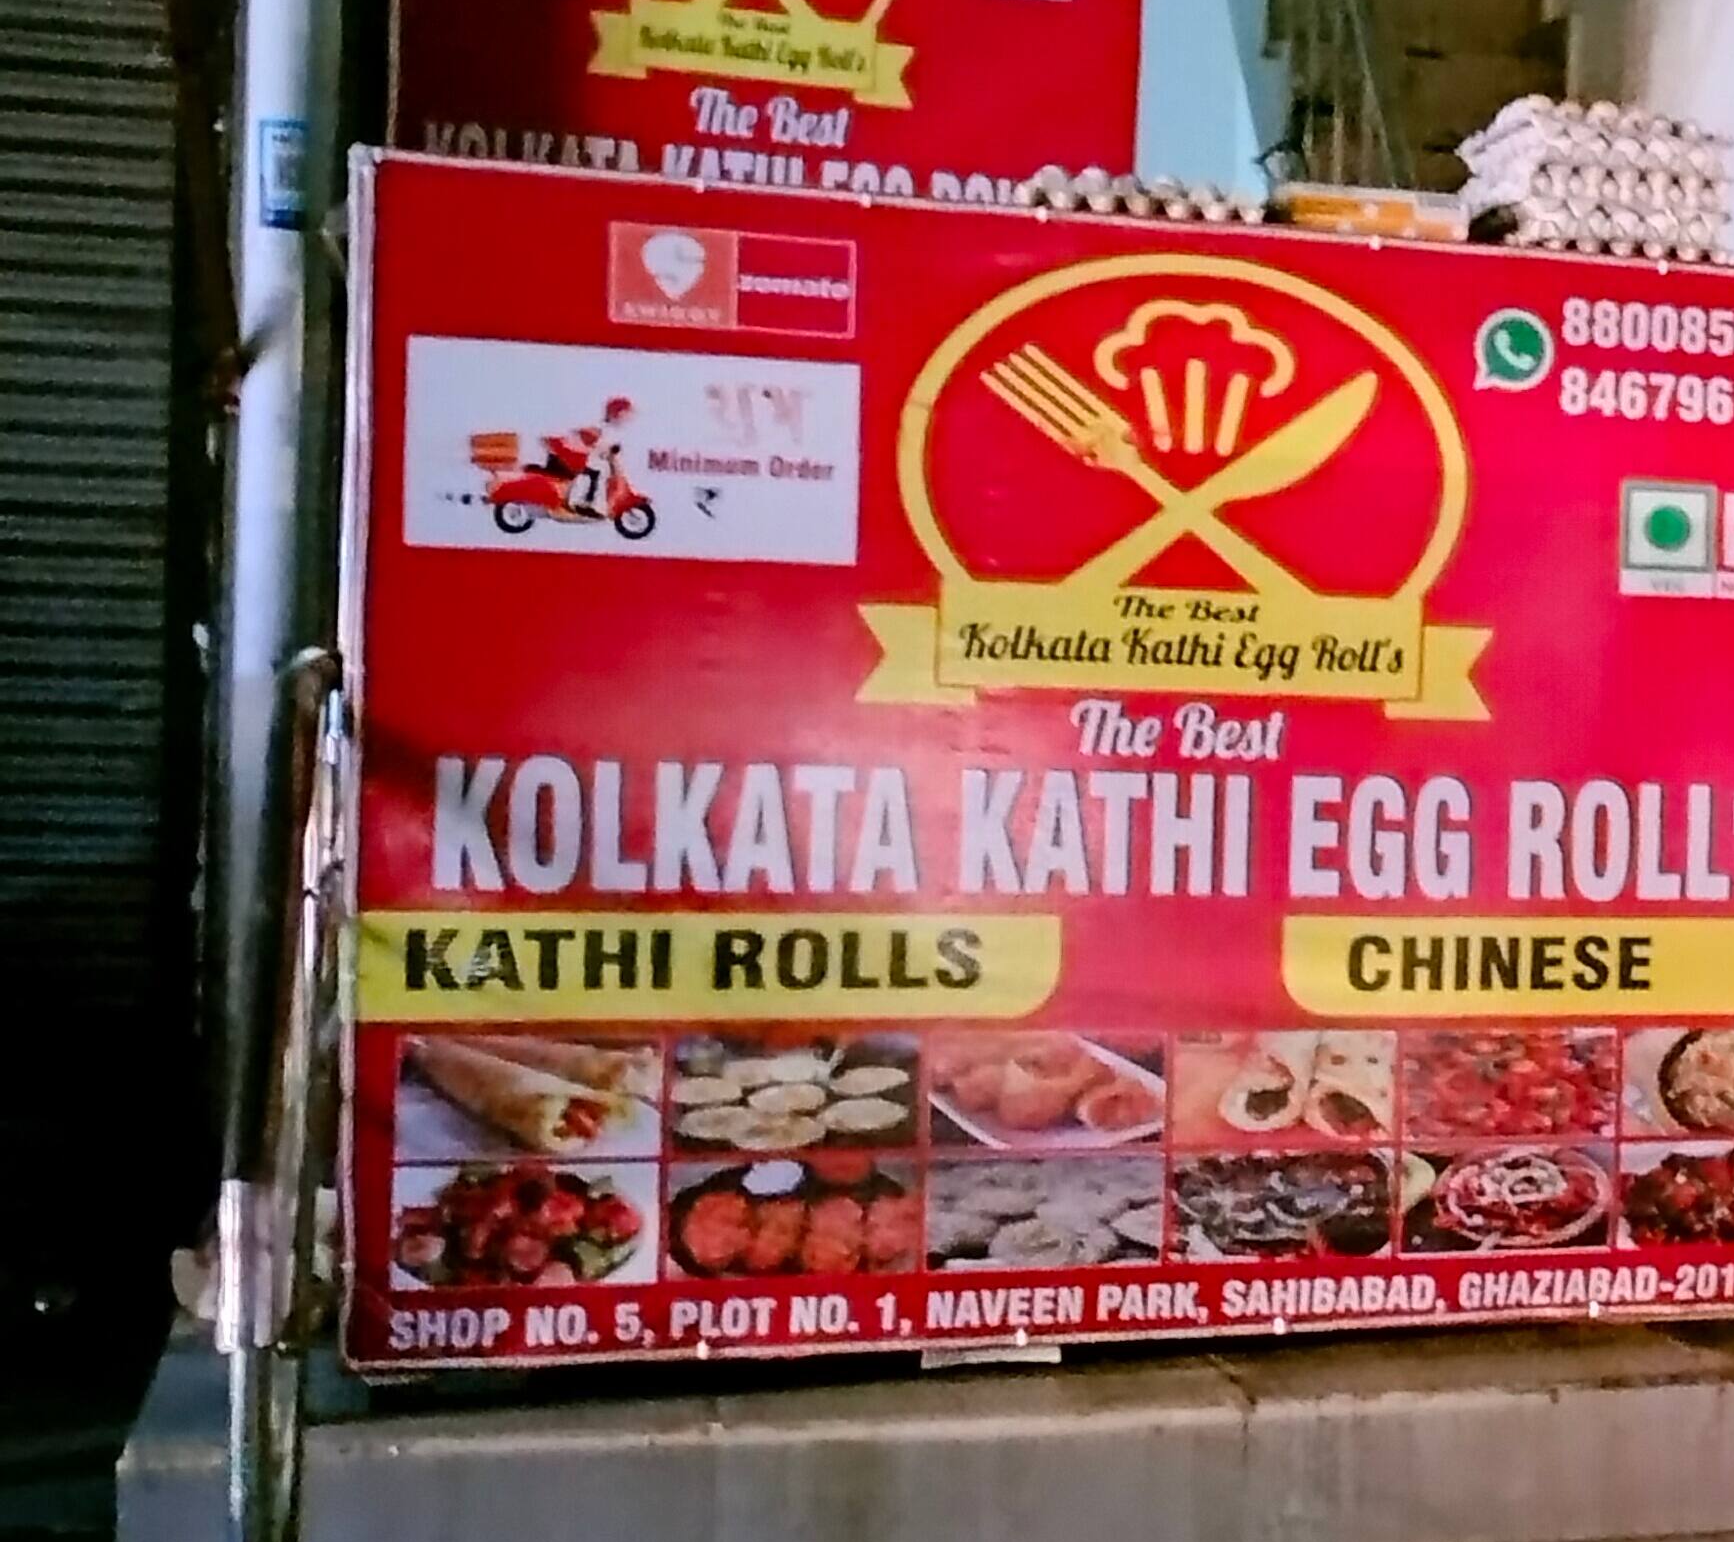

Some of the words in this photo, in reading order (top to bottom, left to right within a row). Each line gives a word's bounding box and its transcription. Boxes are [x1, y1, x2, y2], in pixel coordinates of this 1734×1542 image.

[690, 85, 758, 139] The
[767, 96, 849, 149] Best
[648, 448, 760, 475] Minimum
[770, 455, 834, 480] Order
[1113, 594, 1175, 620] The
[1185, 599, 1260, 624] Best
[959, 622, 1111, 664] Kolkata
[1121, 628, 1224, 667] Kathi
[1234, 633, 1299, 681] Egg
[1311, 635, 1404, 675] Roll's
[1070, 697, 1161, 758] The
[1174, 701, 1286, 761] Best
[431, 753, 919, 895] KOLKATA
[959, 767, 1251, 897] KATHI
[1289, 773, 1473, 900] EGG
[404, 927, 671, 991] KATHI
[712, 927, 983, 990] ROLLS
[1347, 934, 1653, 992] CHINESE
[389, 1307, 511, 1351] SHOP
[524, 1305, 599, 1348] NO.
[670, 1296, 776, 1340] PLOT
[788, 1292, 858, 1337] NO.
[925, 1284, 1084, 1330] NAVEEN
[1098, 1280, 1210, 1325] PARK,
